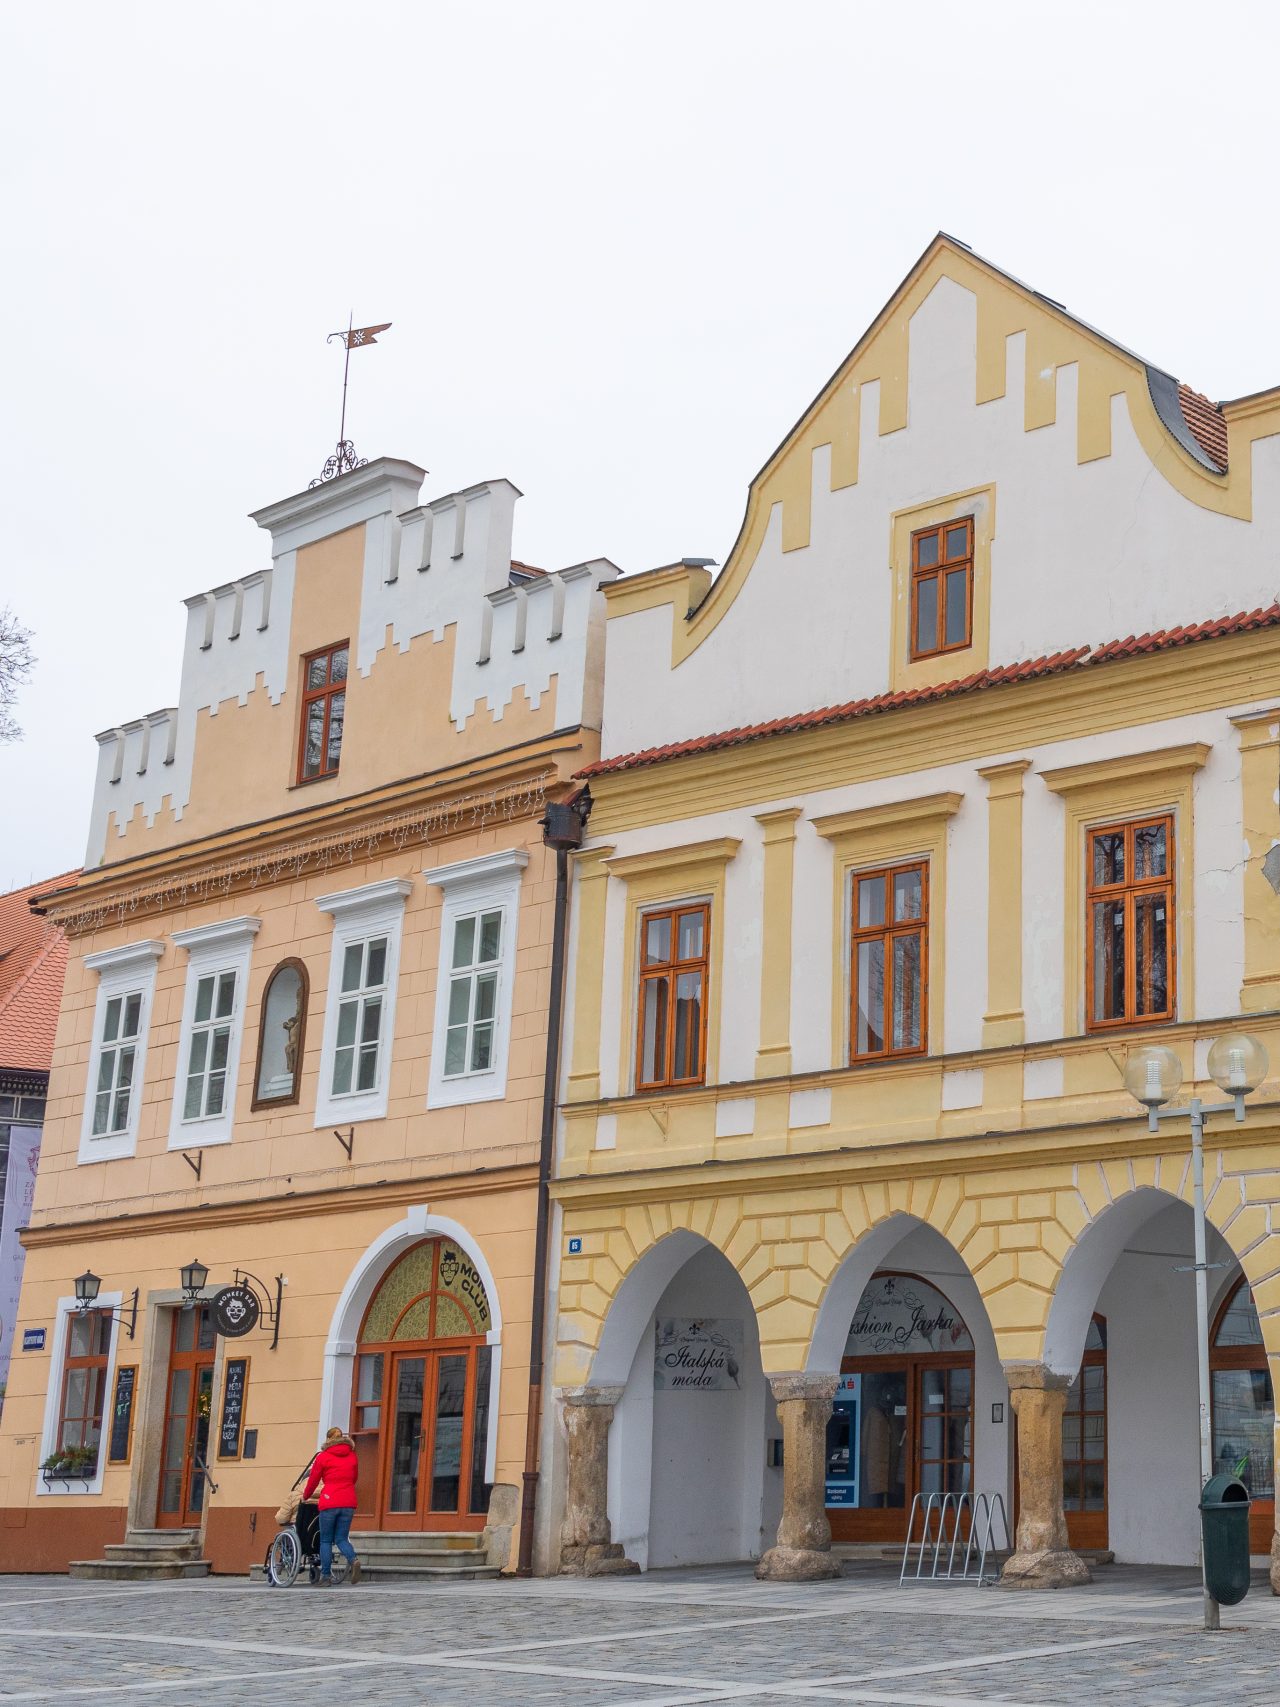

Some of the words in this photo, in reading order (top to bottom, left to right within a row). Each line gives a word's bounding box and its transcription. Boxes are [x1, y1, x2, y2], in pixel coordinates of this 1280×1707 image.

[218, 1291, 244, 1306] MONKEY
[244, 1294, 255, 1308] BAR
[460, 1263, 489, 1307] MON
[461, 1279, 487, 1322] CLUB
[848, 1312, 893, 1335] ashion
[895, 1305, 953, 1343] Jarka
[664, 1346, 725, 1369] Italská
[672, 1367, 712, 1386] móda
